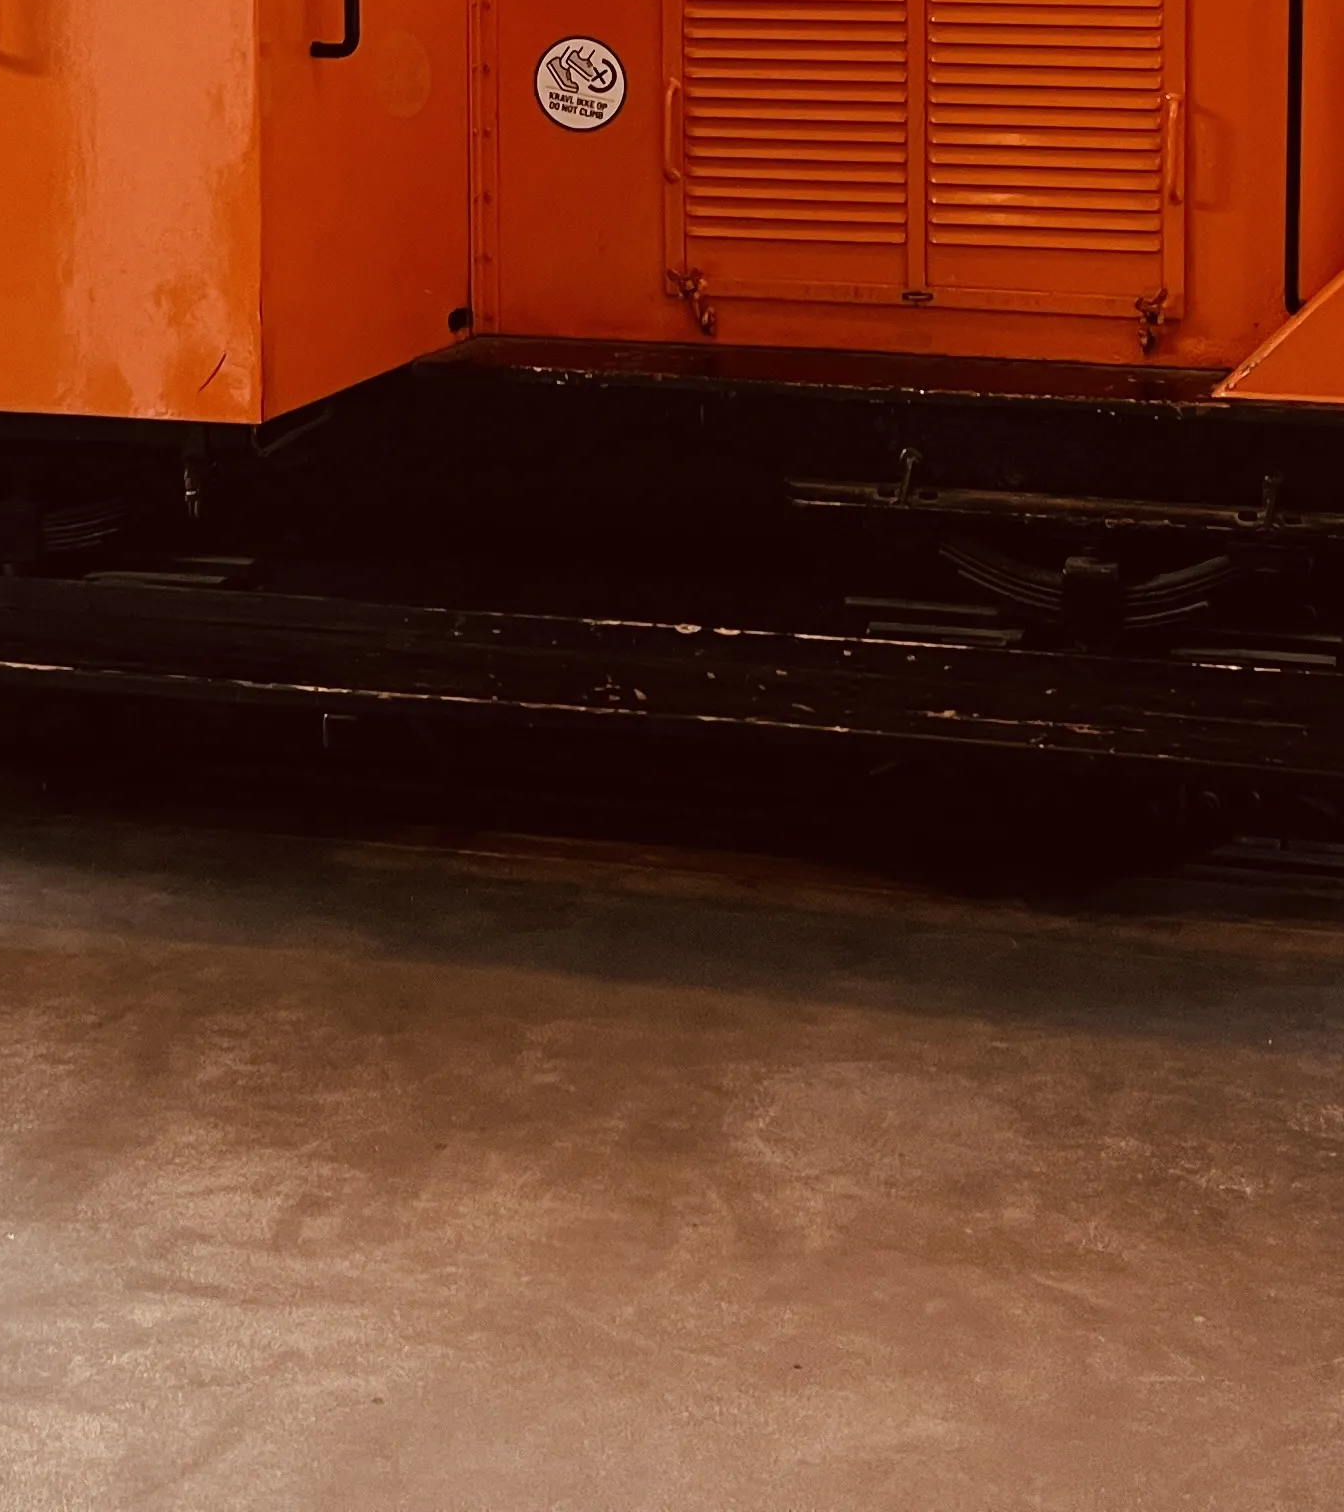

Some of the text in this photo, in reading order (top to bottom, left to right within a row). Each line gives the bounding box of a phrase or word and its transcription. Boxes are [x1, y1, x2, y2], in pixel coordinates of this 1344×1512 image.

[549, 101, 604, 119] DO NOT CLIMB
[596, 102, 607, 110] OP
